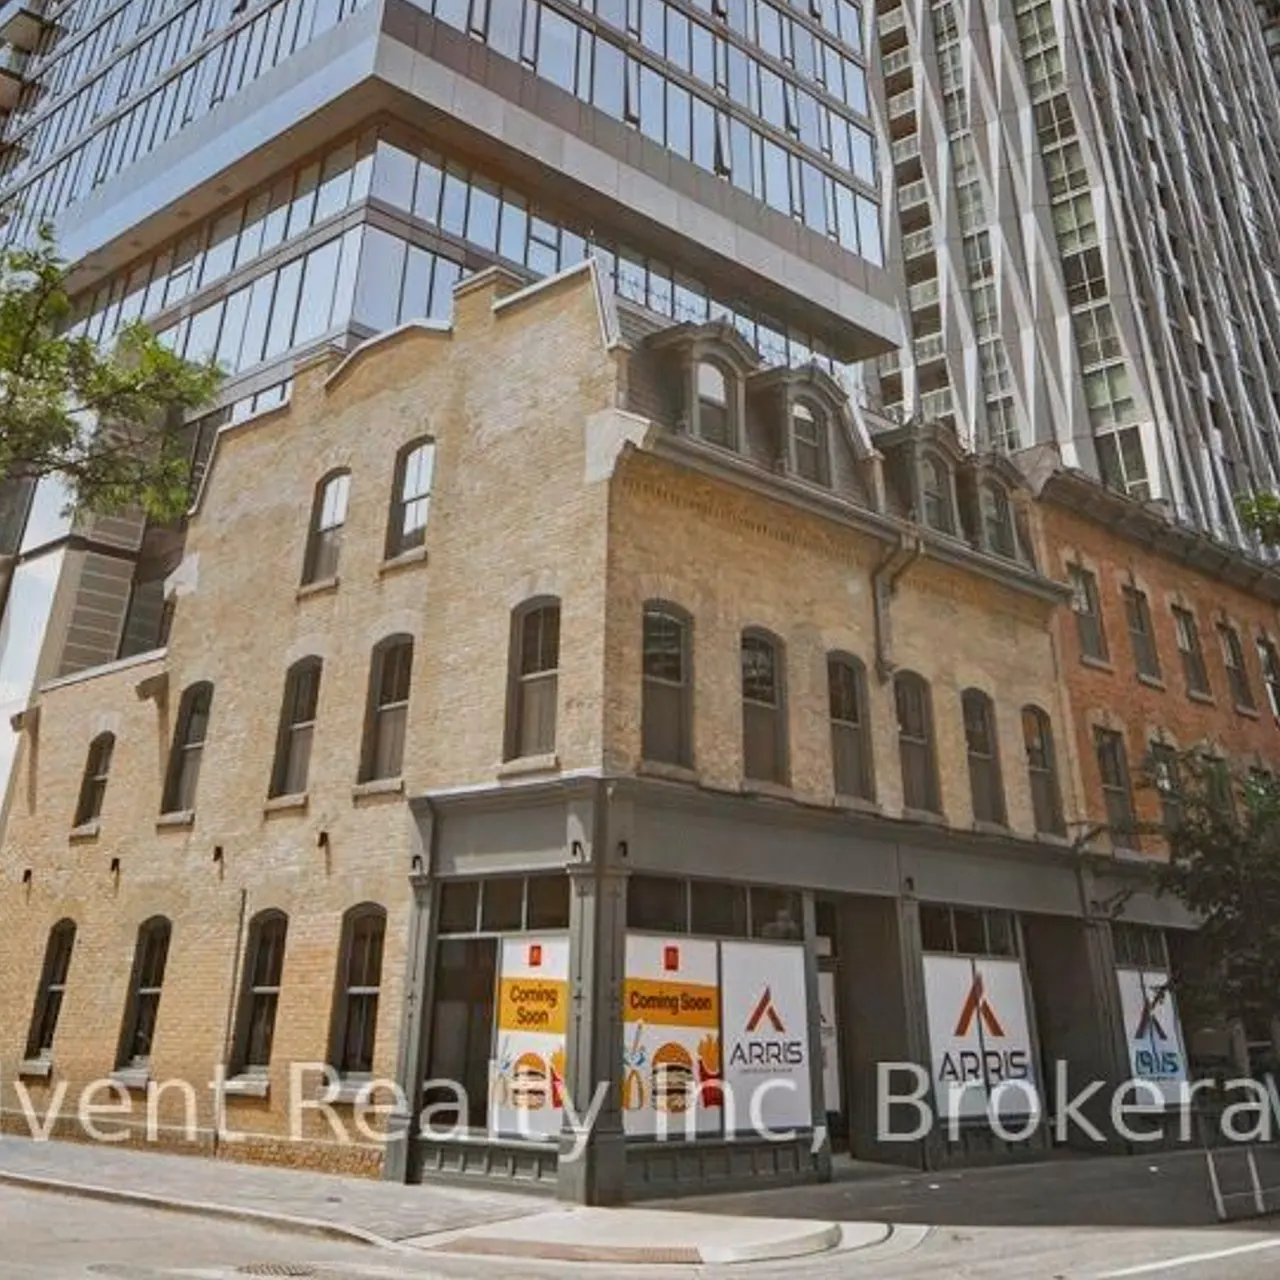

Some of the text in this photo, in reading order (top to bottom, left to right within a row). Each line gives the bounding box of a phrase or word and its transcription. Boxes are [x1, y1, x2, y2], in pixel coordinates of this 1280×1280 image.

[510, 983, 558, 1007] Coming
[630, 990, 712, 1015] Coming Soon
[517, 1007, 550, 1025] Soon
[730, 1042, 803, 1065] ARRIS
[939, 1050, 1028, 1082] ARRIS
